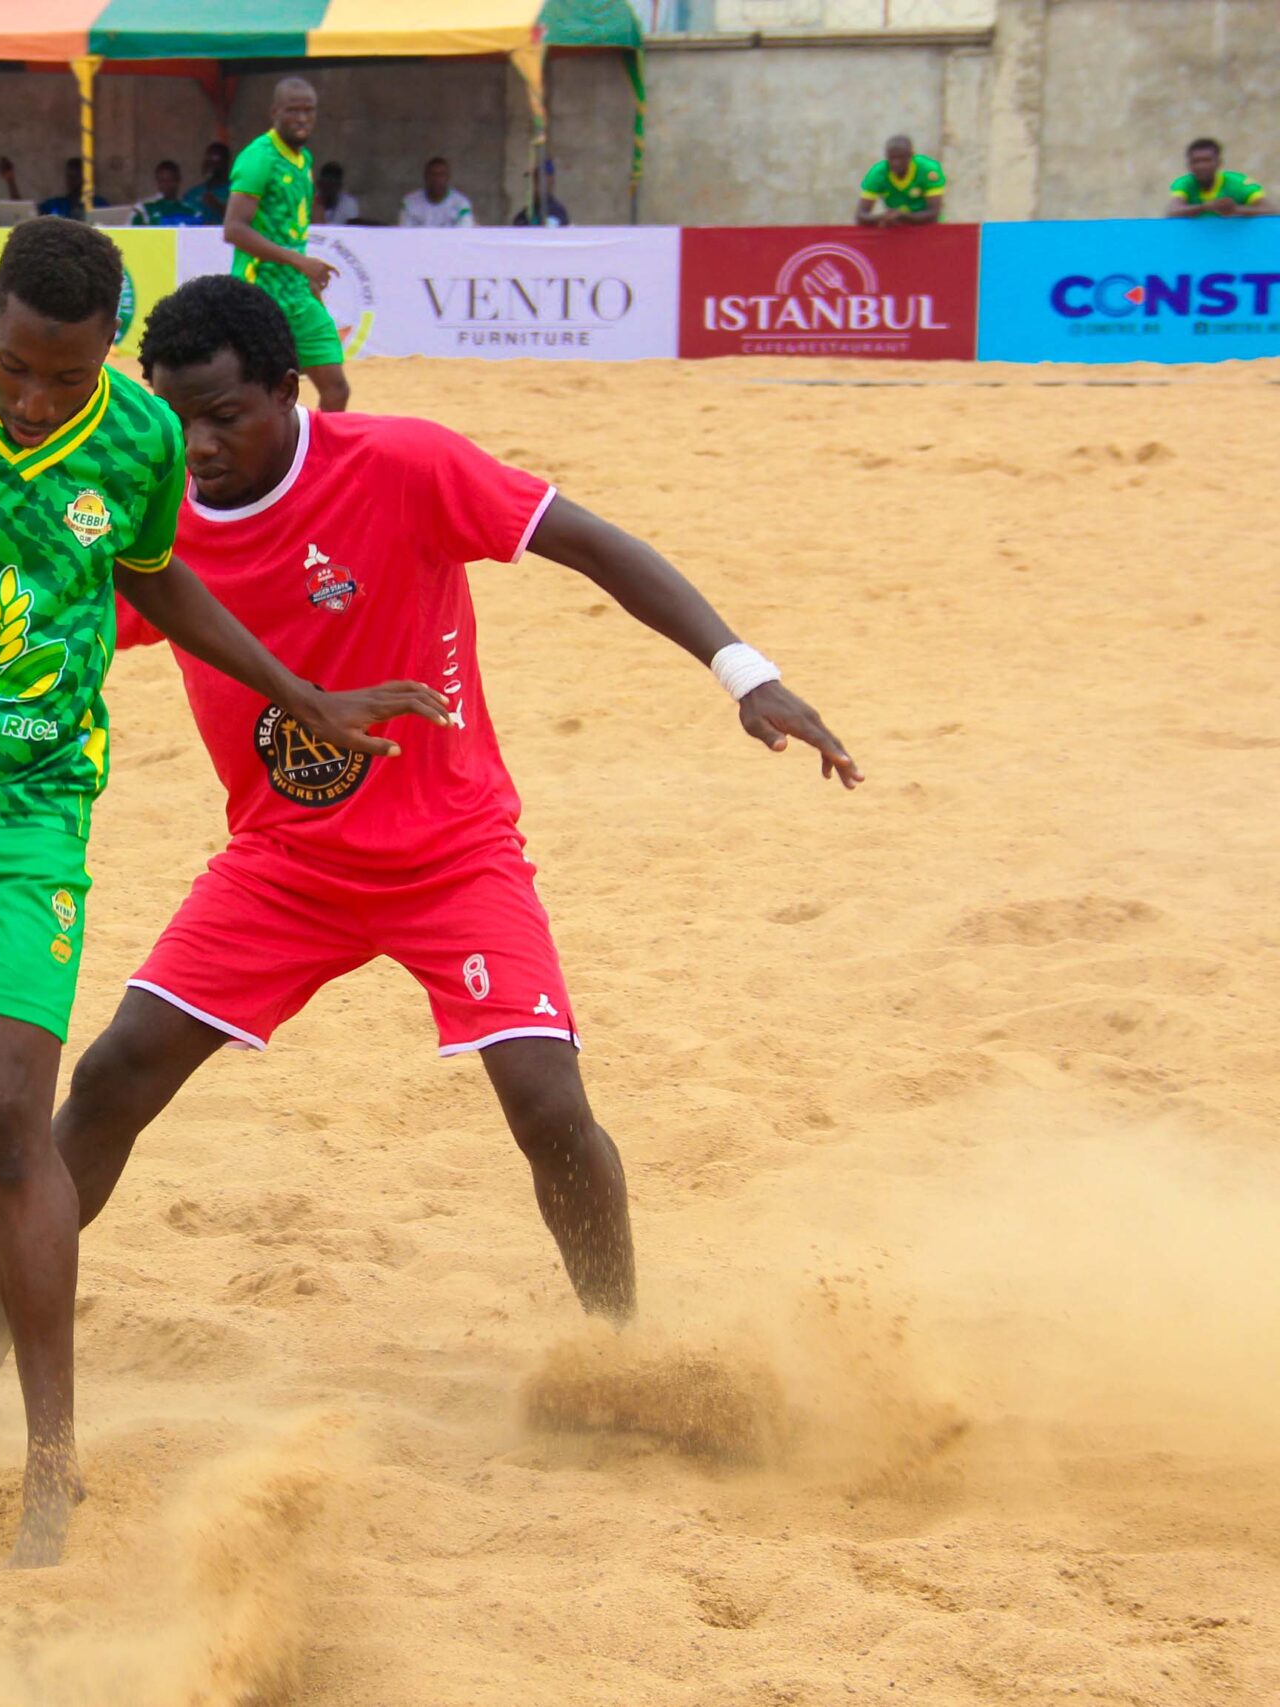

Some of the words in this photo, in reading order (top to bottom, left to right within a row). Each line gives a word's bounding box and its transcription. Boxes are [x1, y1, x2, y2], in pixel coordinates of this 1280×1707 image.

[420, 276, 634, 322] VENTO
[703, 294, 950, 332] ISTANBUL
[457, 330, 592, 347] FURNITURE
[72, 511, 105, 527] KEBBI
[259, 706, 283, 747] BEAC
[272, 767, 314, 801] WHERE
[326, 753, 365, 799] BELONG
[288, 762, 345, 780] HOTEL
[463, 953, 490, 1001] 8
